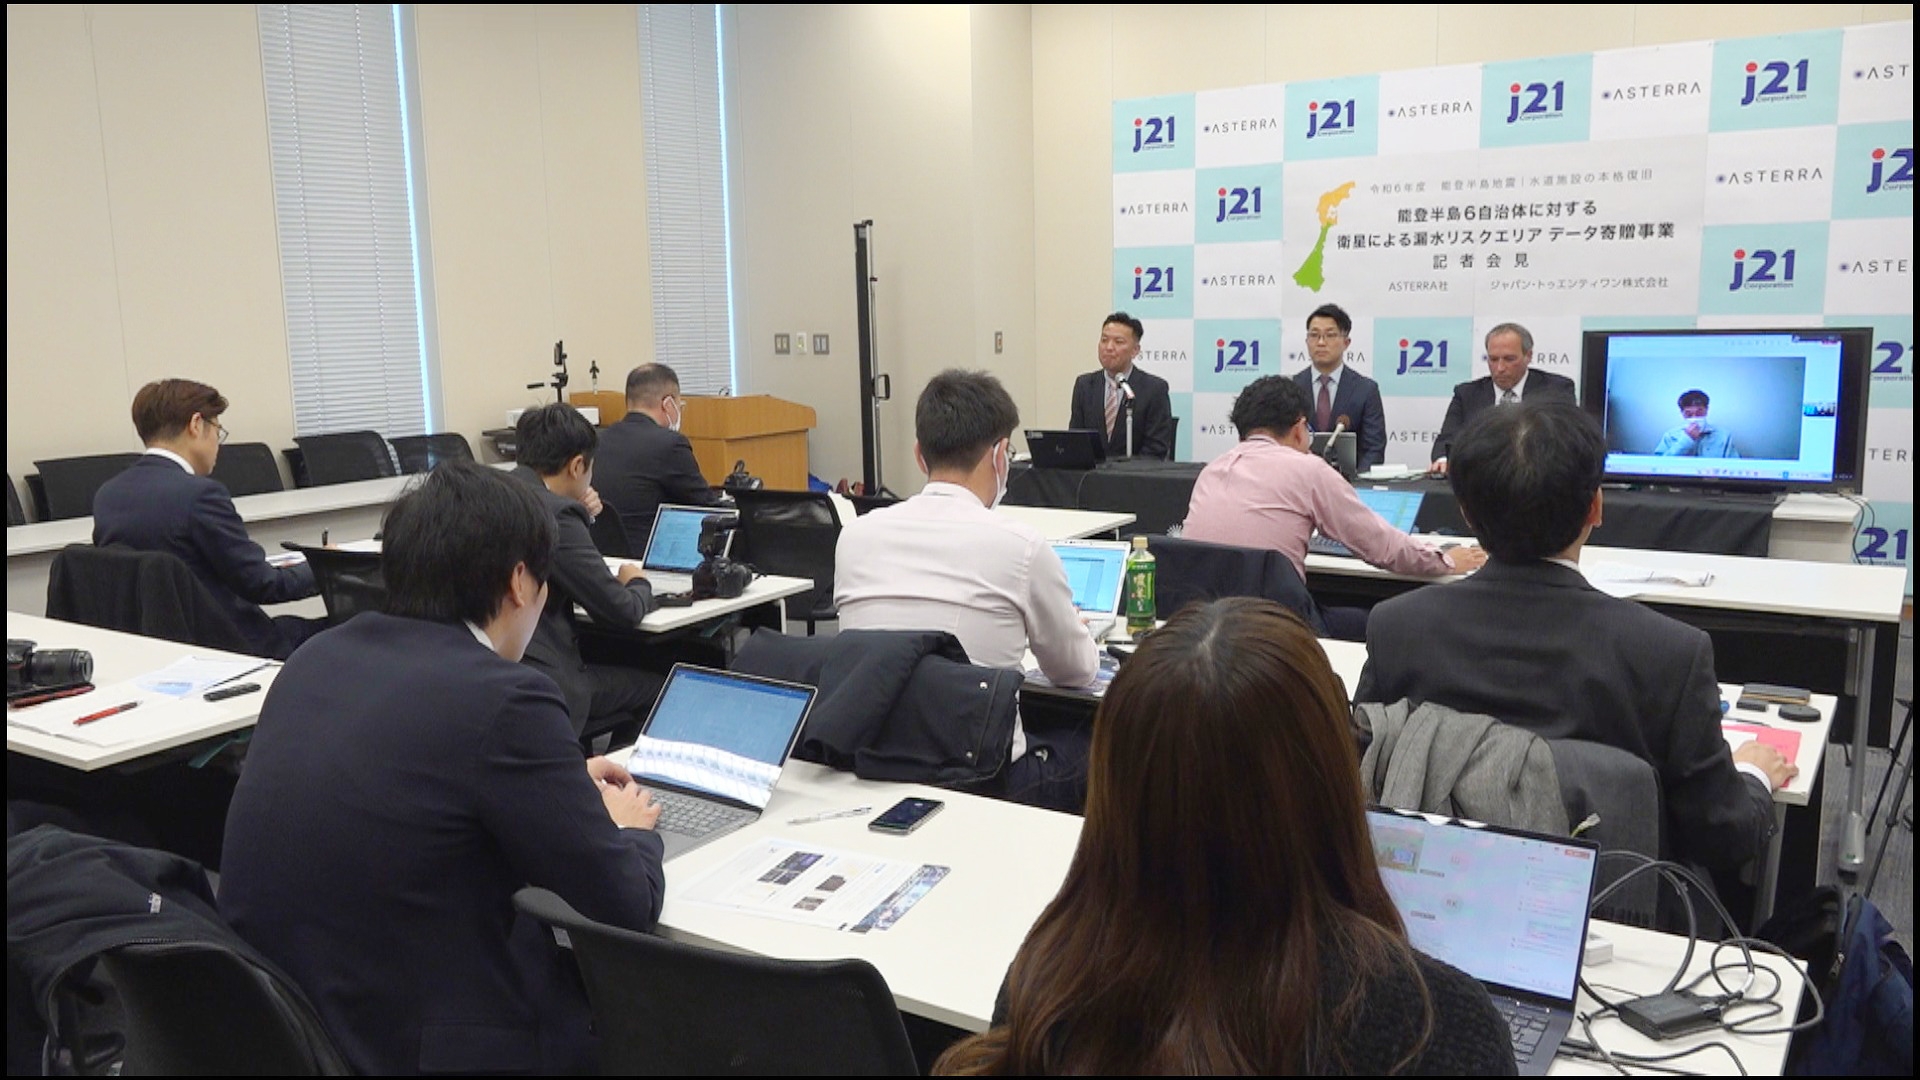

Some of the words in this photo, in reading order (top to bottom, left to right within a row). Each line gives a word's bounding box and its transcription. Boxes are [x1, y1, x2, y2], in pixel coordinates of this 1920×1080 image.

[1612, 81, 1702, 101] ASTERRA
[1740, 58, 1809, 107] j21
[1506, 79, 1565, 125] j21
[1755, 93, 1807, 103] Corporation
[1306, 98, 1356, 139] j21
[1397, 100, 1473, 118] ASTERRA
[1132, 115, 1176, 154] j21
[1211, 117, 1278, 134] ASTERRA
[1728, 167, 1823, 185] ASTERRA
[1127, 201, 1189, 216] ASTERRA
[1216, 185, 1262, 223] j21
[1728, 248, 1796, 292] j21
[1132, 266, 1175, 301] j21
[1209, 274, 1276, 287] ASTERRA
[1387, 279, 1449, 293] ASTERRA社
[1743, 282, 1795, 290] Corporation
[1137, 349, 1187, 362] STERRA
[1214, 338, 1260, 374] j21
[1396, 338, 1449, 376] j21
